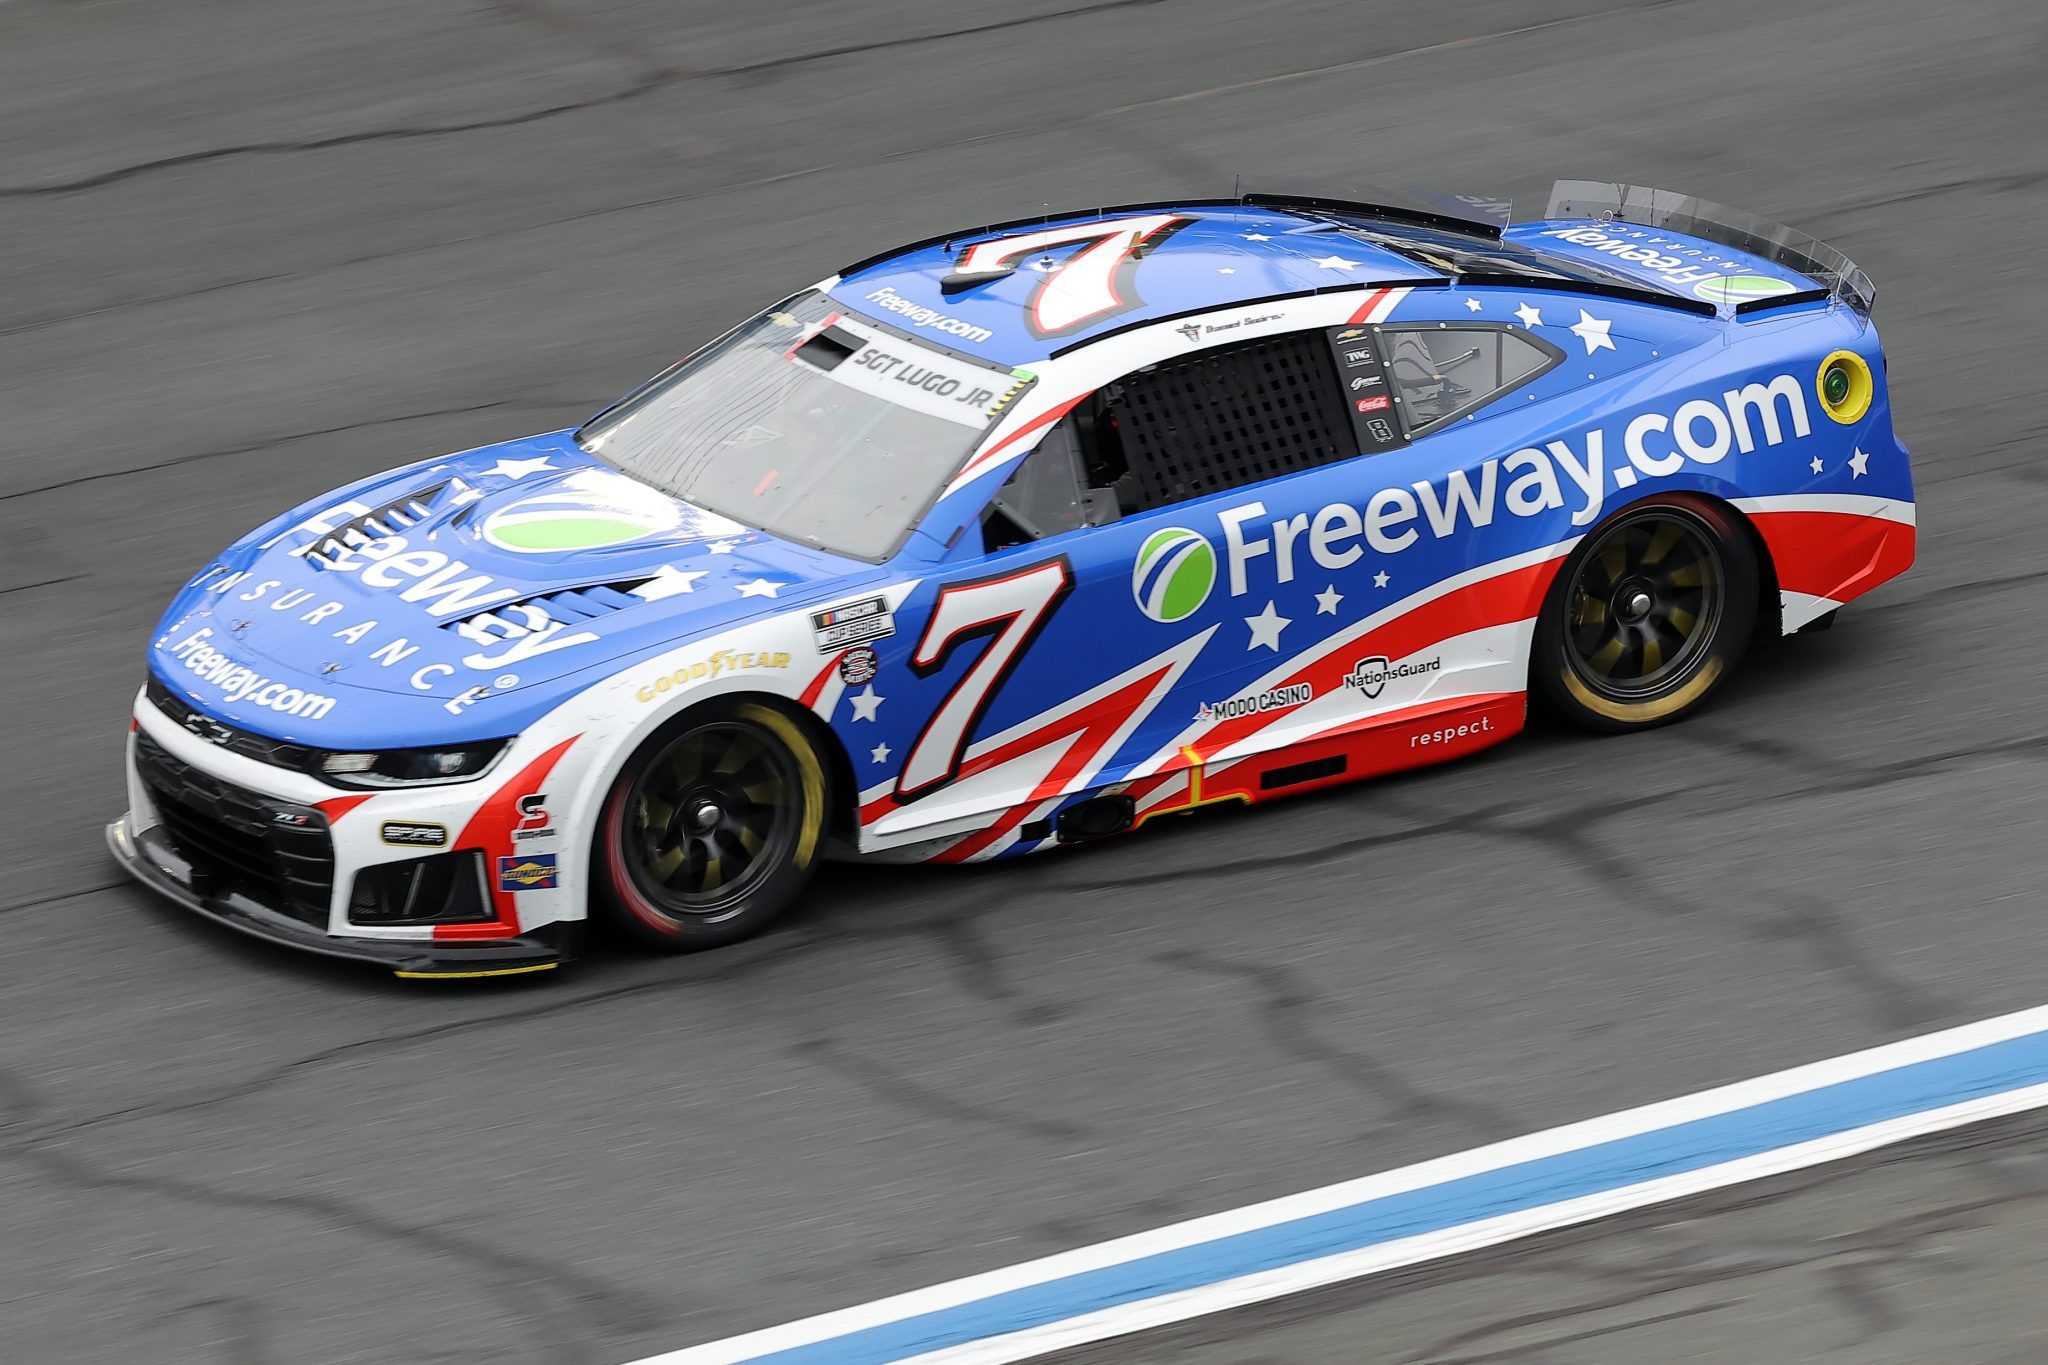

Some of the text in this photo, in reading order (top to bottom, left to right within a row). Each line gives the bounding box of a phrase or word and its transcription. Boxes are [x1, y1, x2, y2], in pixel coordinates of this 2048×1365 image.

[955, 212, 1204, 341] 7
[1541, 227, 1721, 284] Freeway
[865, 286, 993, 343] Freeway.com
[854, 349, 994, 408] SGT LUGO JR
[1216, 373, 1812, 597] Freeway.com
[257, 501, 601, 670] Freeway
[190, 567, 491, 715] INSURANCE
[170, 627, 337, 719] Freeway.com
[636, 650, 791, 703] GOODYEAR
[893, 552, 1076, 806] 7
[1213, 684, 1311, 721] MODO CASINO
[1345, 657, 1441, 689] NationsGuard
[1410, 717, 1495, 748] respect.
